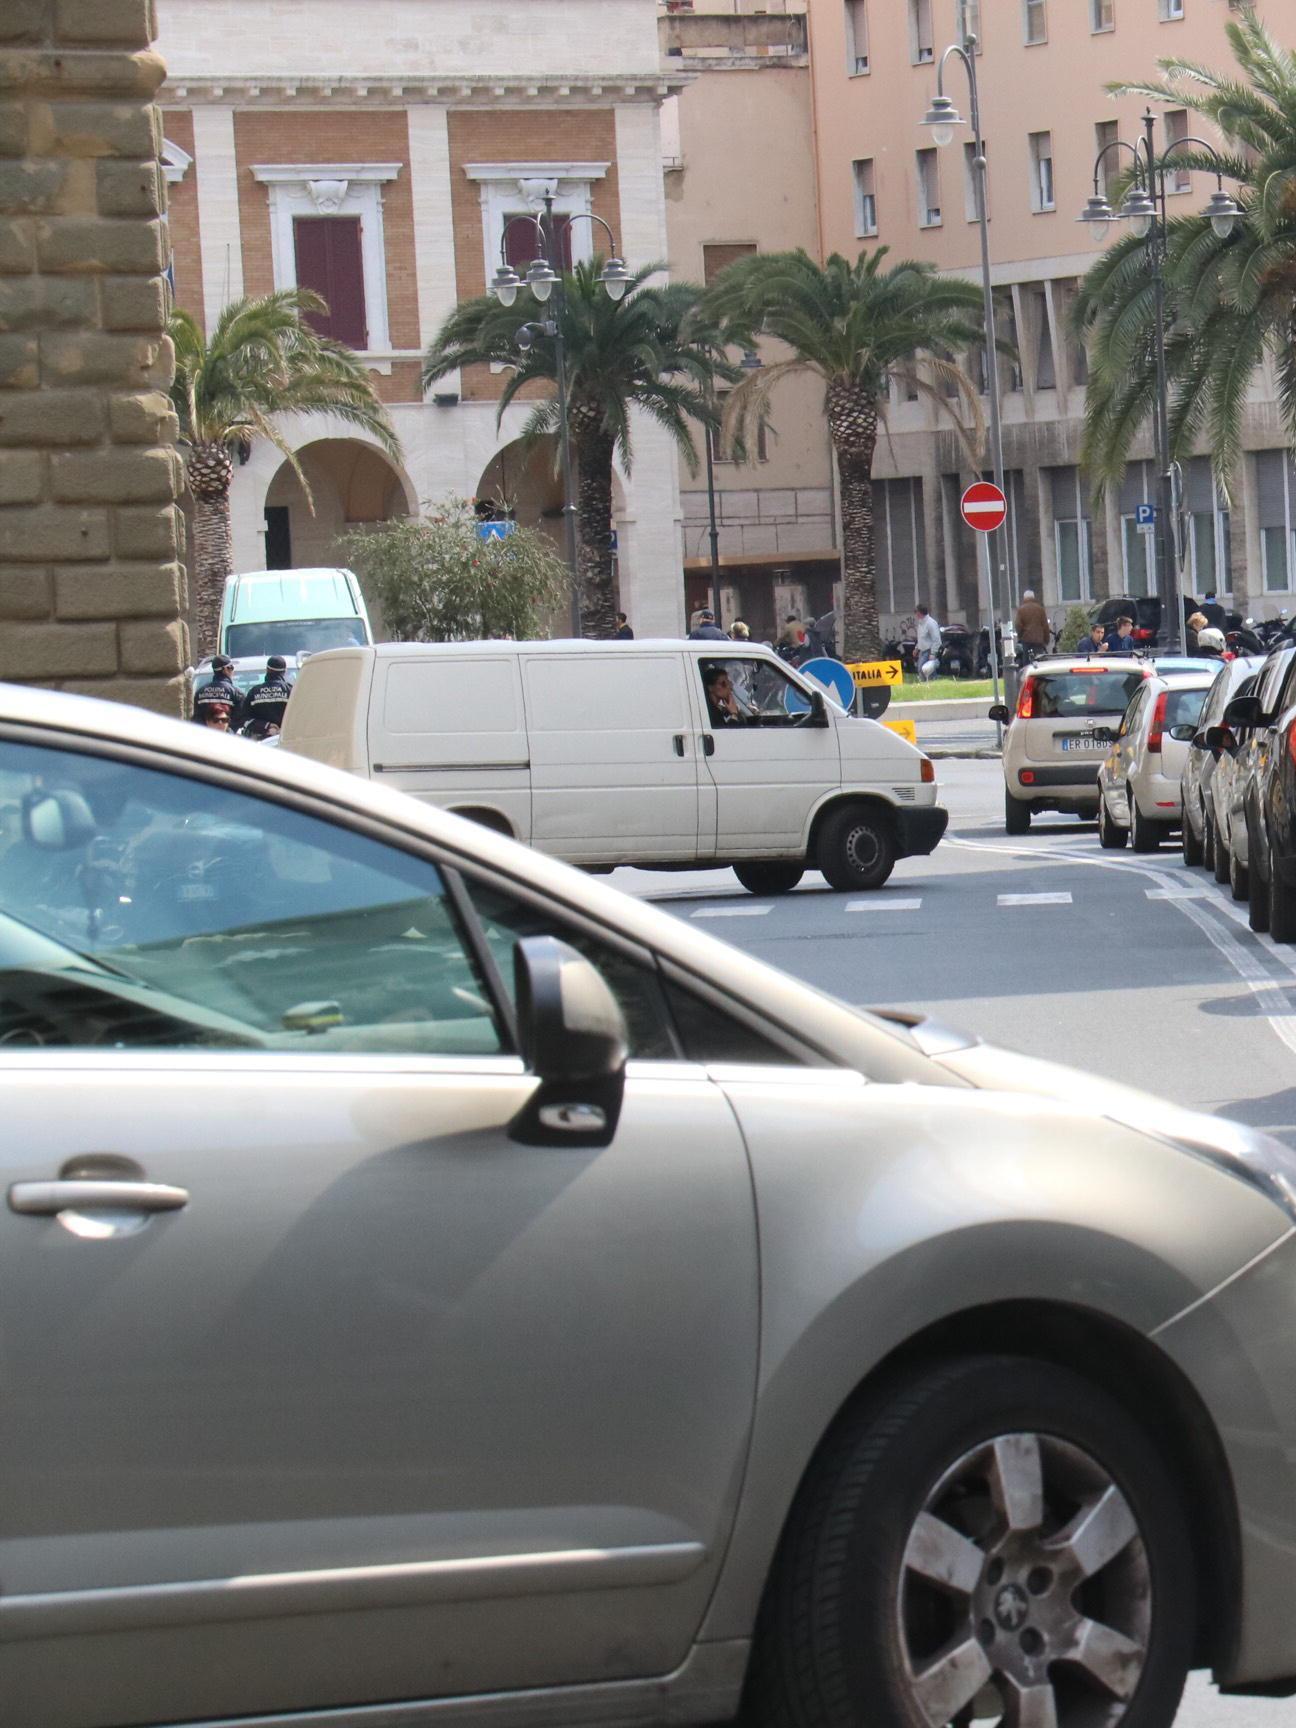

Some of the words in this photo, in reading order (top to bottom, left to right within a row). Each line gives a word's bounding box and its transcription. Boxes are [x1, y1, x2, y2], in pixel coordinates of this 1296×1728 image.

[1138, 506, 1151, 522] P
[853, 668, 882, 680] ITALIA
[254, 692, 288, 700] MUNICIPALE
